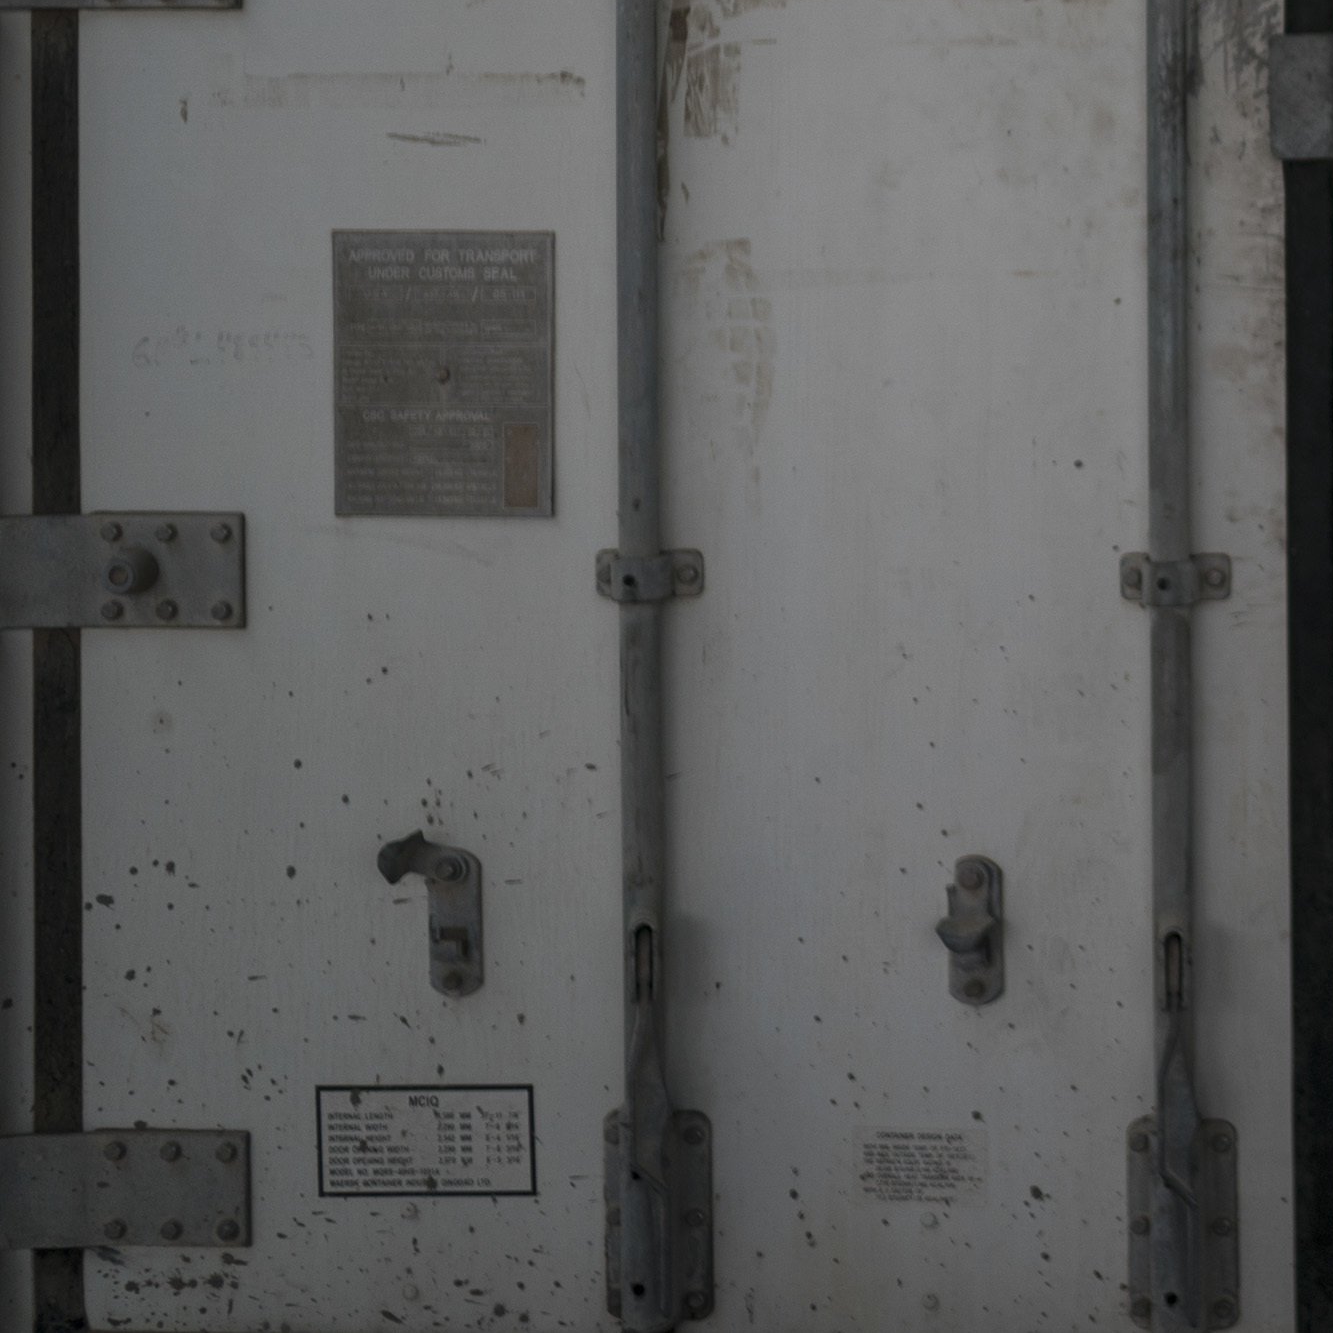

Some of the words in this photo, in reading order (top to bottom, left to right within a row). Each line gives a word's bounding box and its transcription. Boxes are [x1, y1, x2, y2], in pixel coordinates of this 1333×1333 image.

[349, 249, 414, 261] APPROVED
[425, 249, 450, 263] FOR
[459, 249, 536, 263] TRANSPORT
[368, 267, 409, 279] UNDER
[419, 267, 475, 280] CUSTOMS
[408, 1096, 439, 1108] MCIQ
